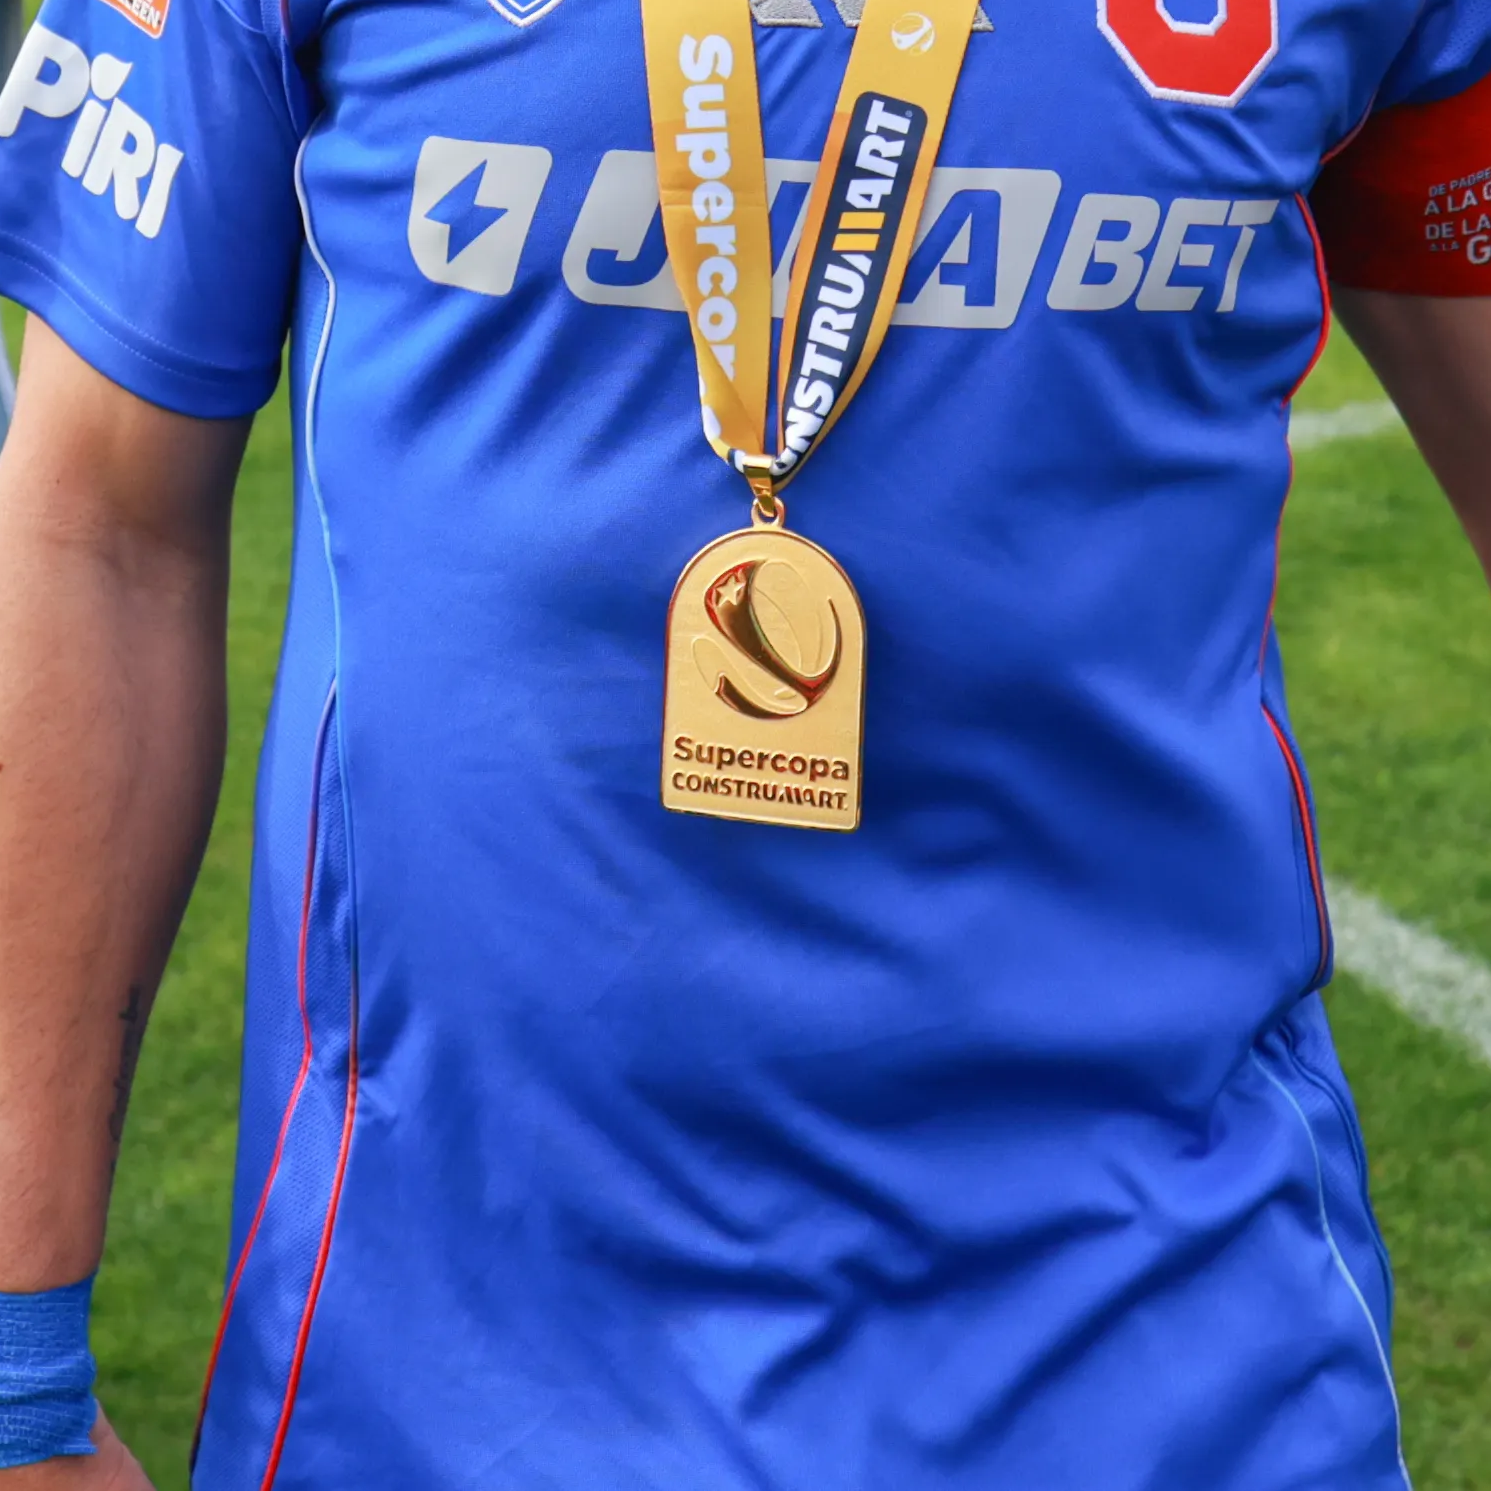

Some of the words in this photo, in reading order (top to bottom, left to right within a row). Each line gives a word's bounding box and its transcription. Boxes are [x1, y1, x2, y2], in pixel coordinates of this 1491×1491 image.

[1424, 199, 1440, 216] A
[1447, 189, 1478, 213] LA
[1425, 221, 1454, 240] DE
[1462, 213, 1491, 236] LA
[672, 735, 851, 782] Supercopa
